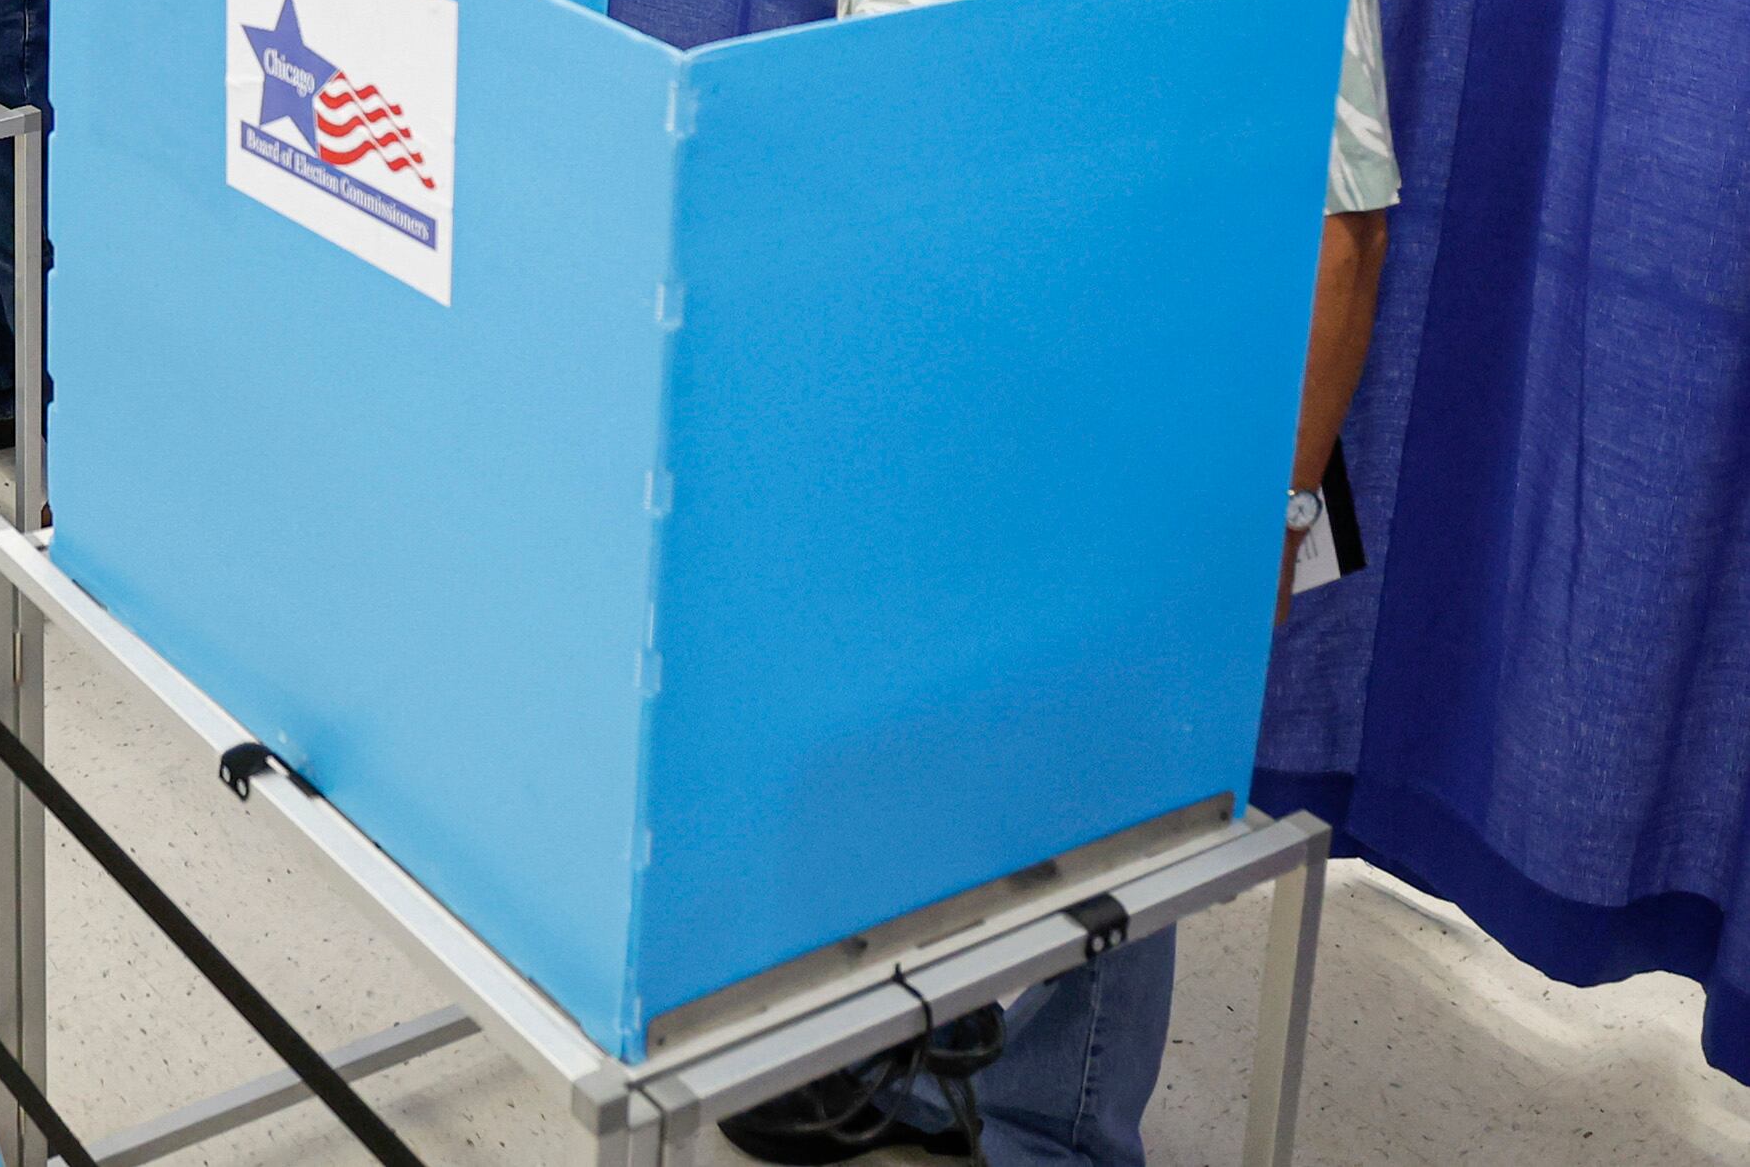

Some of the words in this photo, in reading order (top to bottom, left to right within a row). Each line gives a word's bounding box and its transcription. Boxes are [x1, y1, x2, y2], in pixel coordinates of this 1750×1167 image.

[263, 47, 315, 98] Chicago
[246, 128, 280, 164] Board
[281, 150, 293, 169] of
[295, 152, 339, 194] Election
[340, 177, 430, 241] Commissioners
